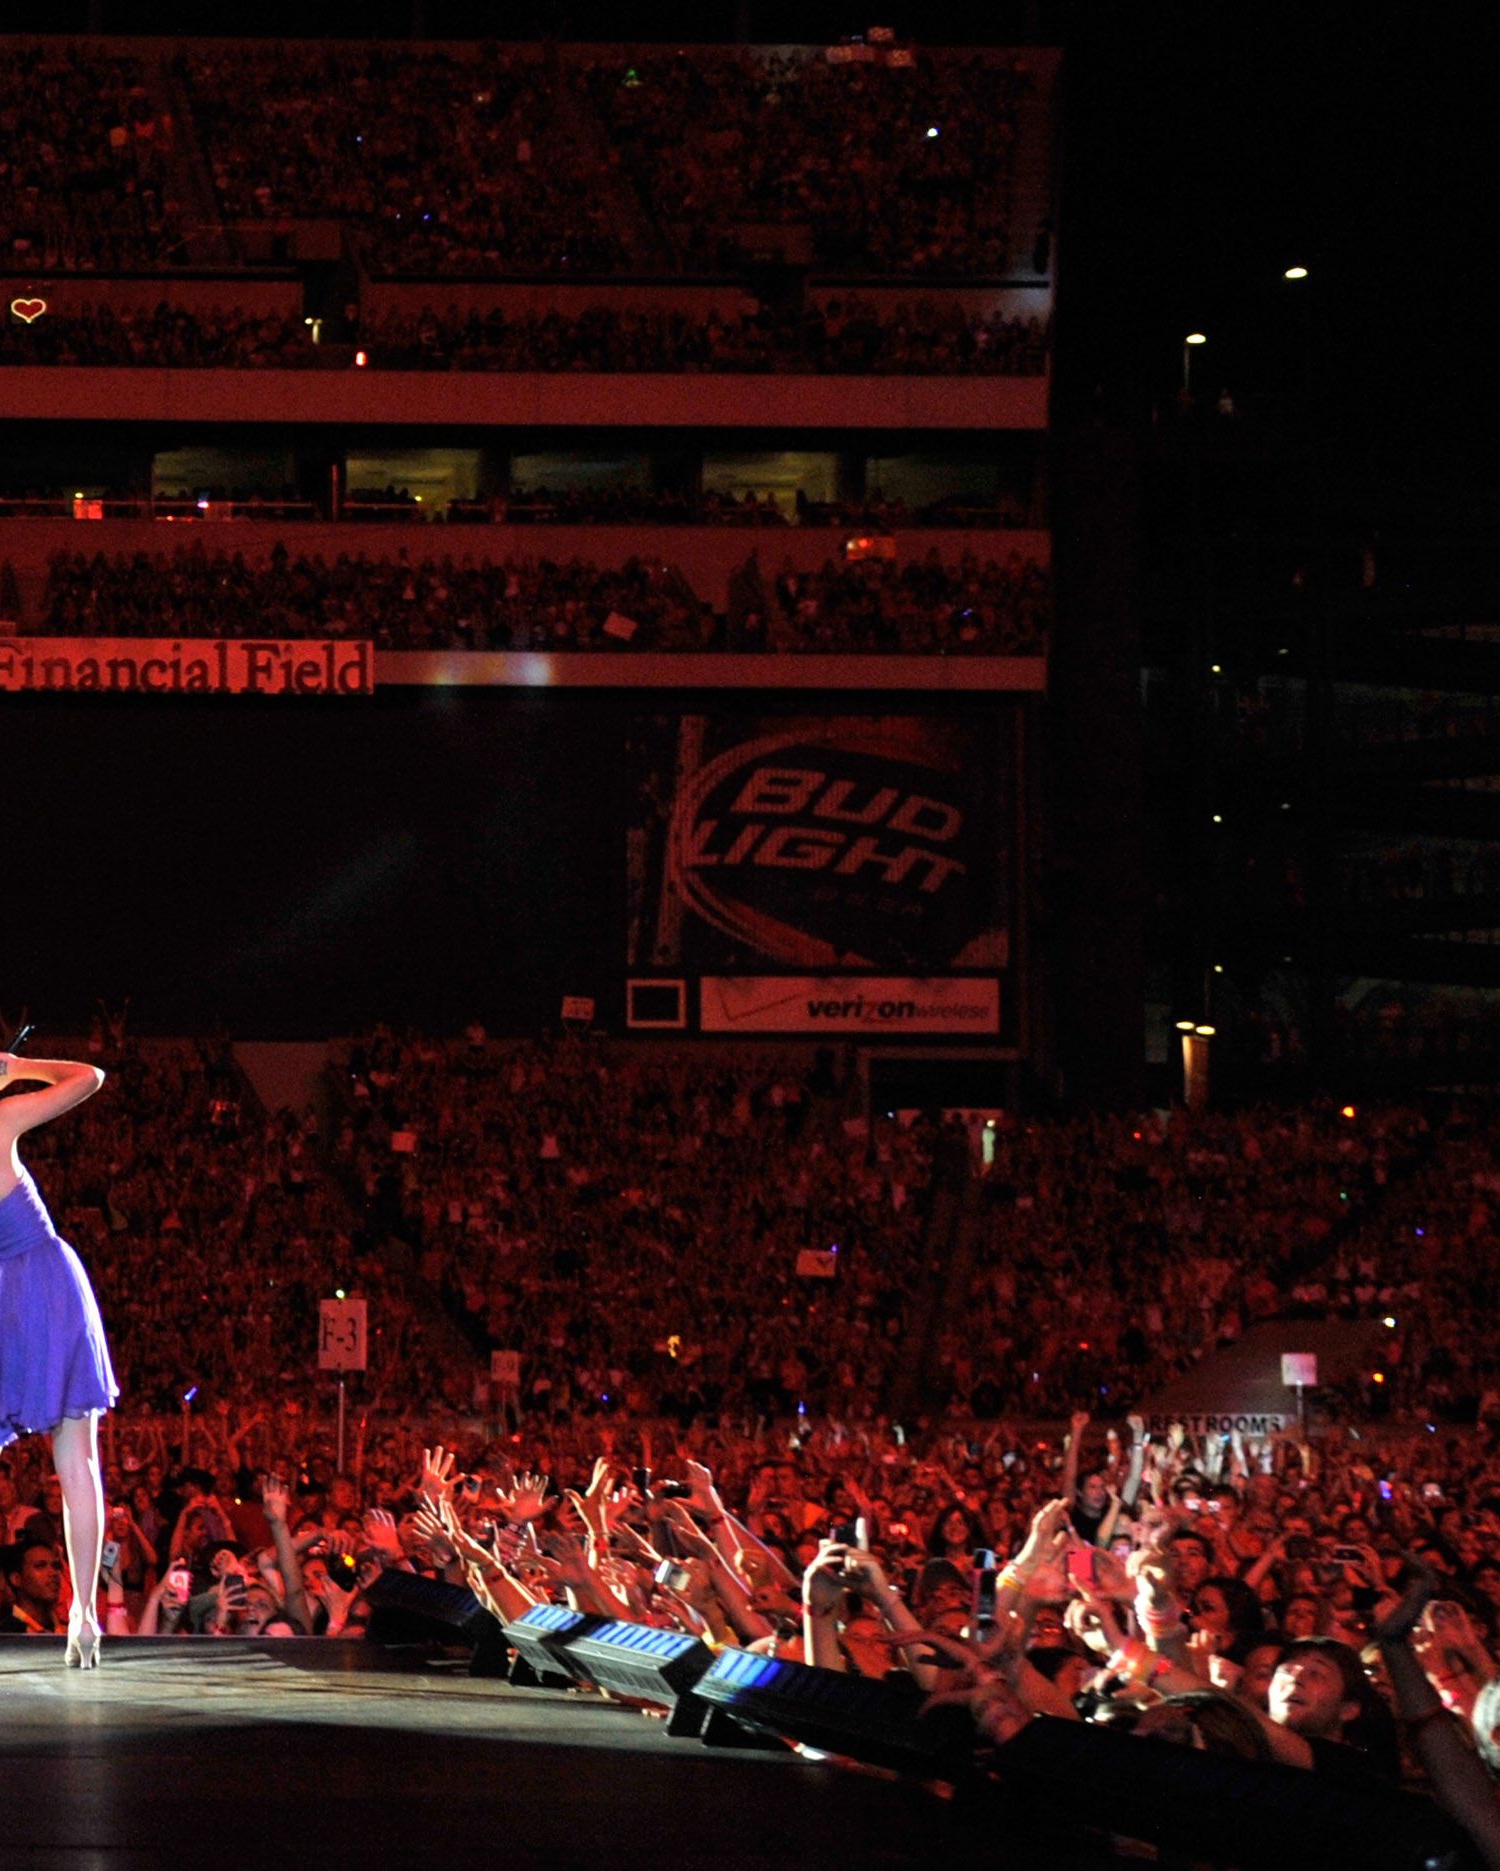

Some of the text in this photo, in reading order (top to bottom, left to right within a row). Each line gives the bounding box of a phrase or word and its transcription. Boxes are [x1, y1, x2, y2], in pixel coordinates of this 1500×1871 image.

[241, 641, 371, 694] Field
[730, 767, 965, 842] BUD
[681, 819, 967, 894] LIGHT
[322, 1316, 357, 1352] F-3
